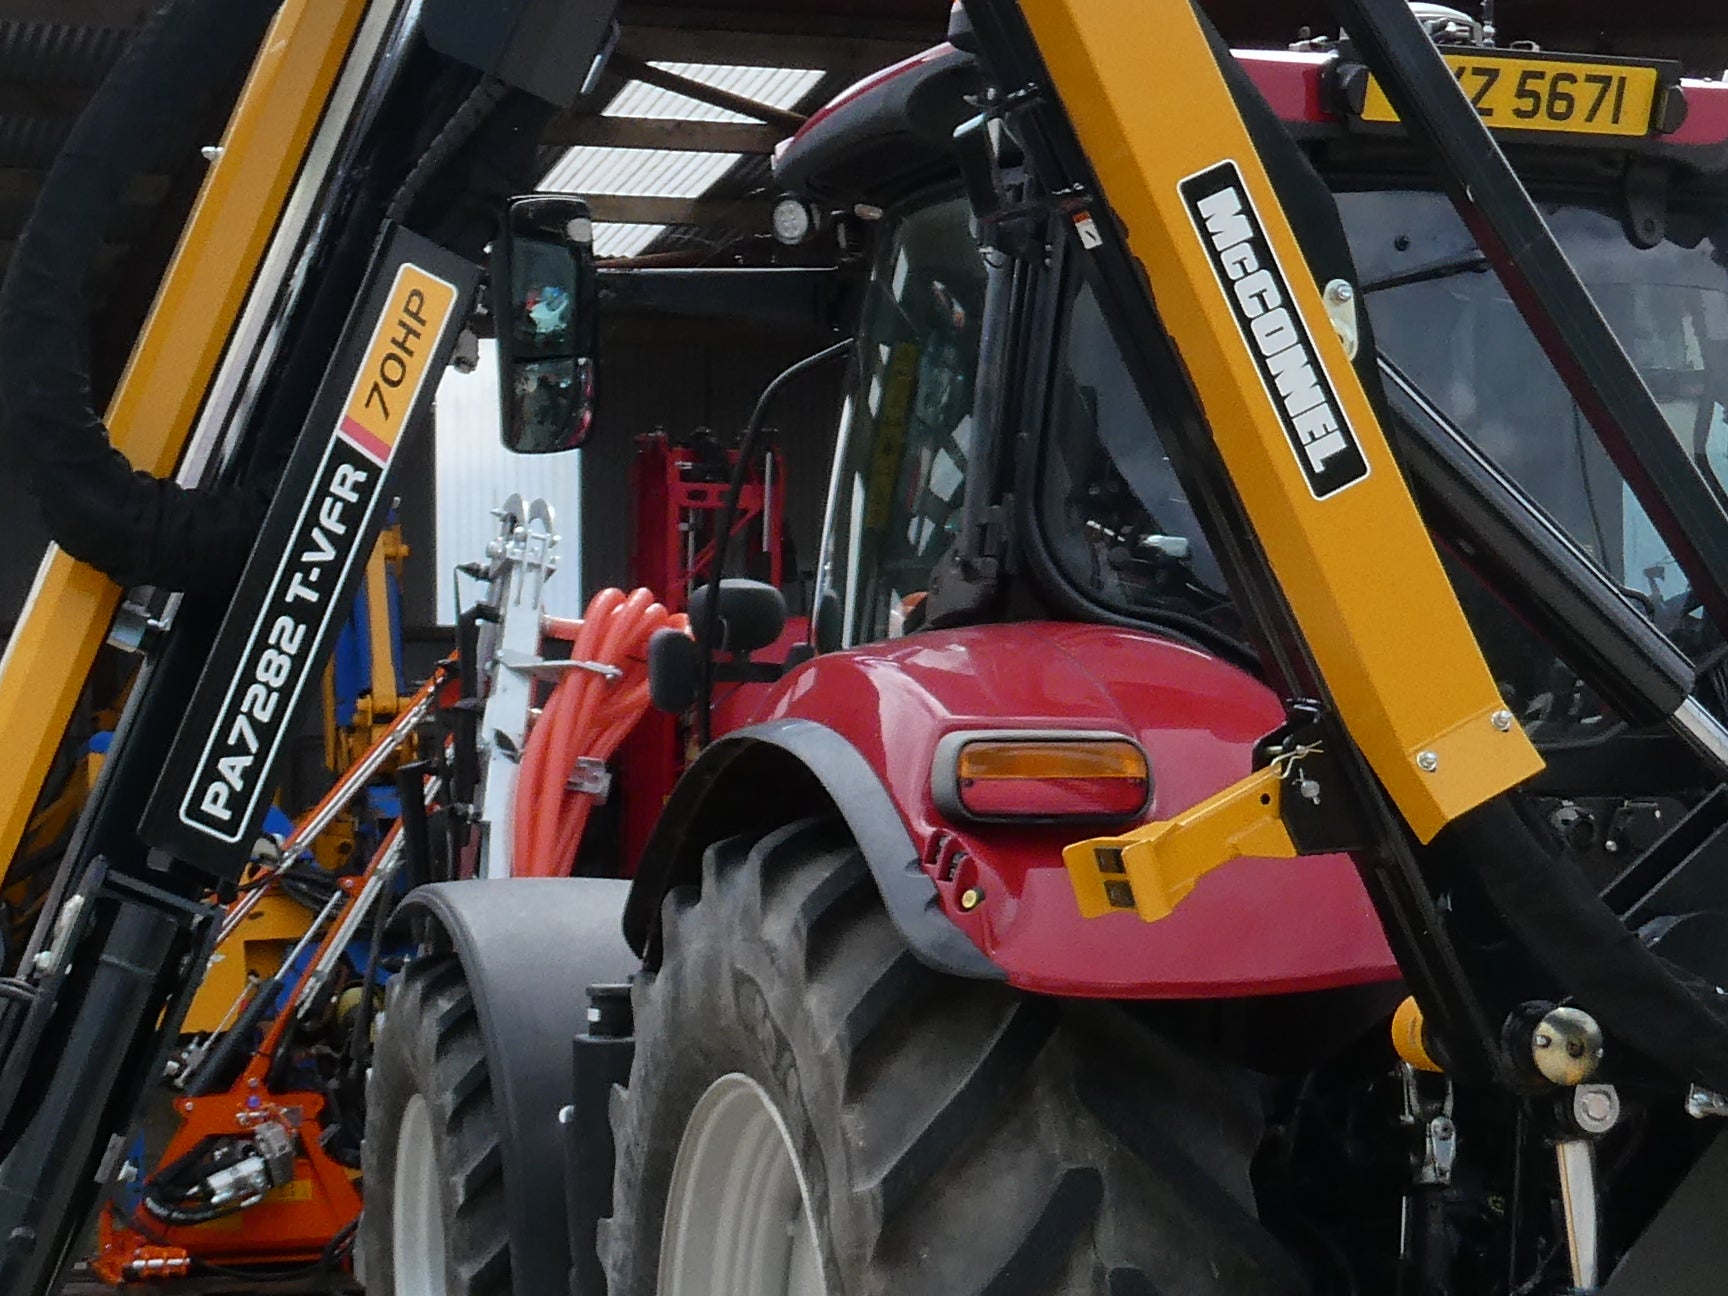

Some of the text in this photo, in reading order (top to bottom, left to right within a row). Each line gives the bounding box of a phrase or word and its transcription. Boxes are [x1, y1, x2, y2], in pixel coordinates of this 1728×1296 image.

[1512, 70, 1627, 125] 5671
[364, 288, 427, 422] 70HP
[200, 462, 369, 821] PA7282 T-VFR
